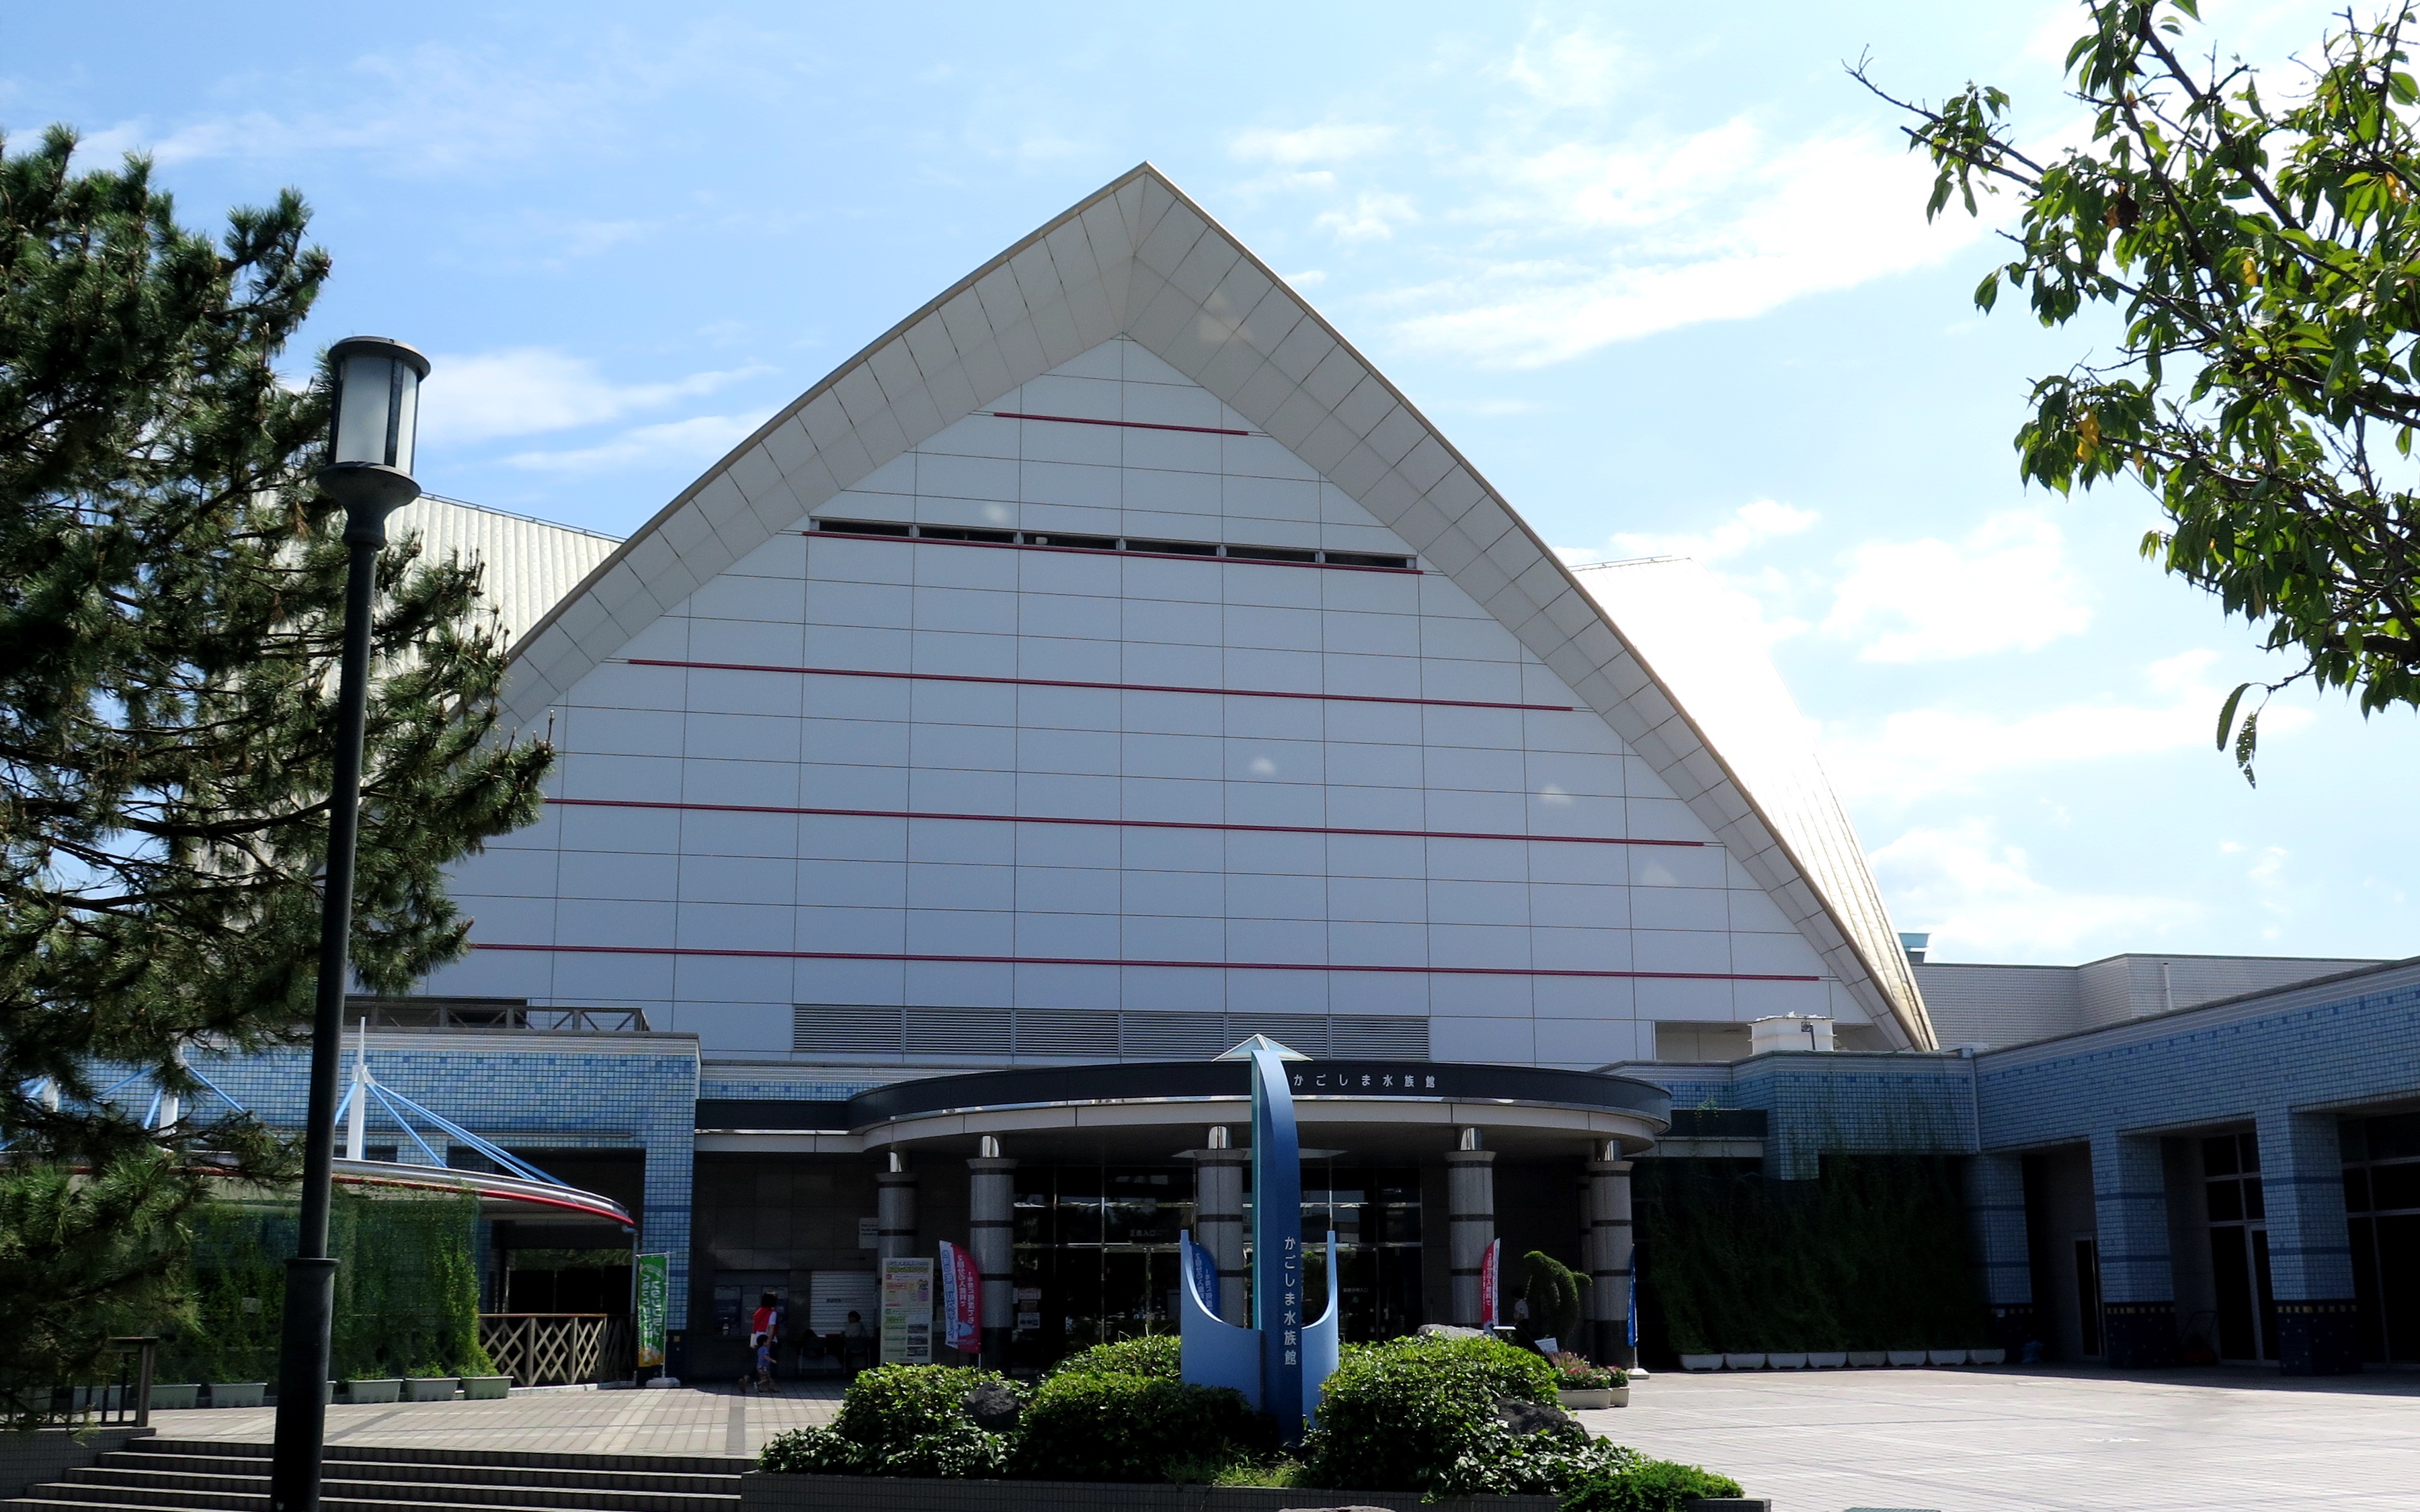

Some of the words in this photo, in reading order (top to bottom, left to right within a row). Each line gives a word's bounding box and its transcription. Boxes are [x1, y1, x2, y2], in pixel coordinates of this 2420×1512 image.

[1293, 1073, 1436, 1089] かごしま水族館
[1284, 1236, 1297, 1366] かごしま水族館
